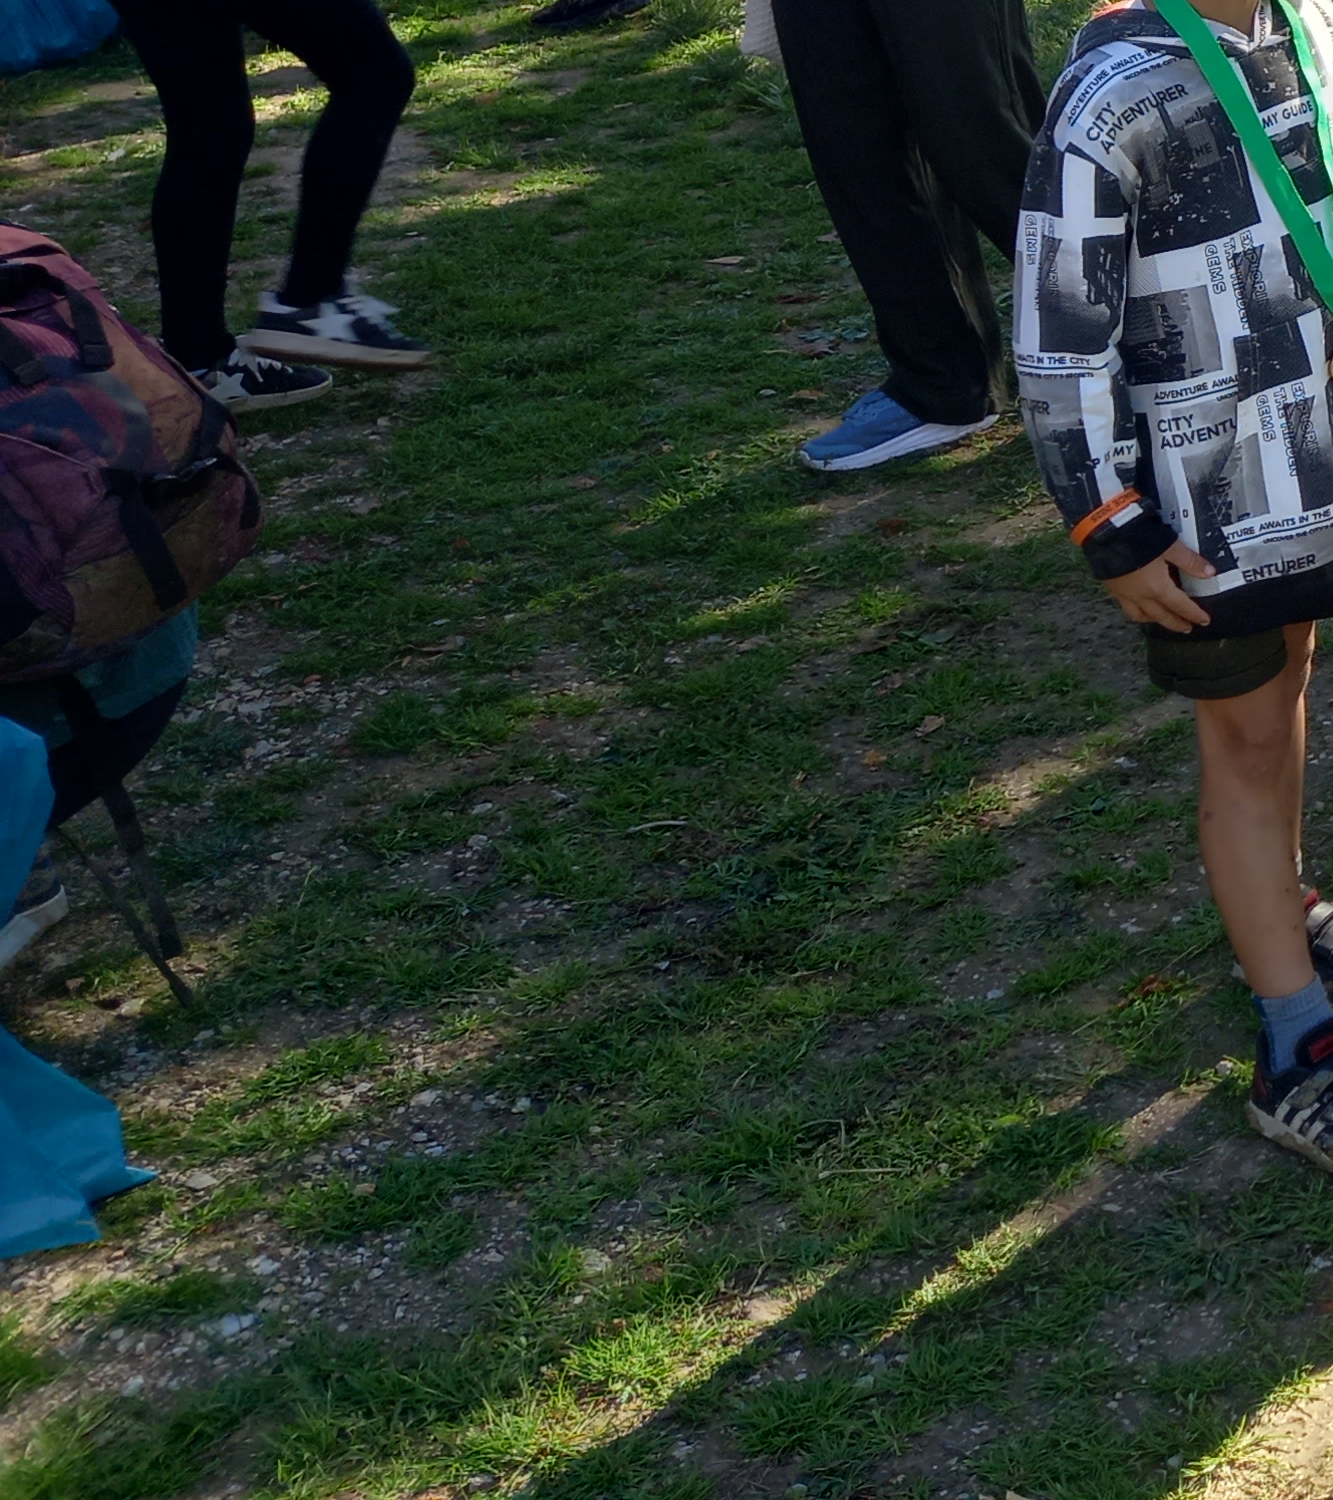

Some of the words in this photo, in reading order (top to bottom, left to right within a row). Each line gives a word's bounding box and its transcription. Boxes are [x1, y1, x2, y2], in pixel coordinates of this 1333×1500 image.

[1067, 68, 1110, 125] ADVENTURE
[1109, 52, 1145, 73] AWAITS
[1085, 100, 1117, 142] CITY
[1099, 83, 1190, 156] ADVENTURER
[1261, 111, 1279, 129] MY
[1282, 100, 1314, 120] GUIDE
[1024, 214, 1038, 266] GEMS
[1204, 244, 1227, 295] GEMS
[1046, 355, 1067, 365] THE
[1069, 357, 1091, 365] CITY
[1154, 381, 1209, 402] ADVENTURE
[1157, 413, 1194, 434] CITY
[1160, 417, 1238, 450] ADVENTU
[1255, 394, 1277, 443] GEMS
[1112, 443, 1135, 458] MY
[1258, 517, 1297, 533] AWAITS
[1298, 513, 1310, 527] IN
[1312, 508, 1332, 521] THE
[1242, 552, 1317, 584] ENTURER
